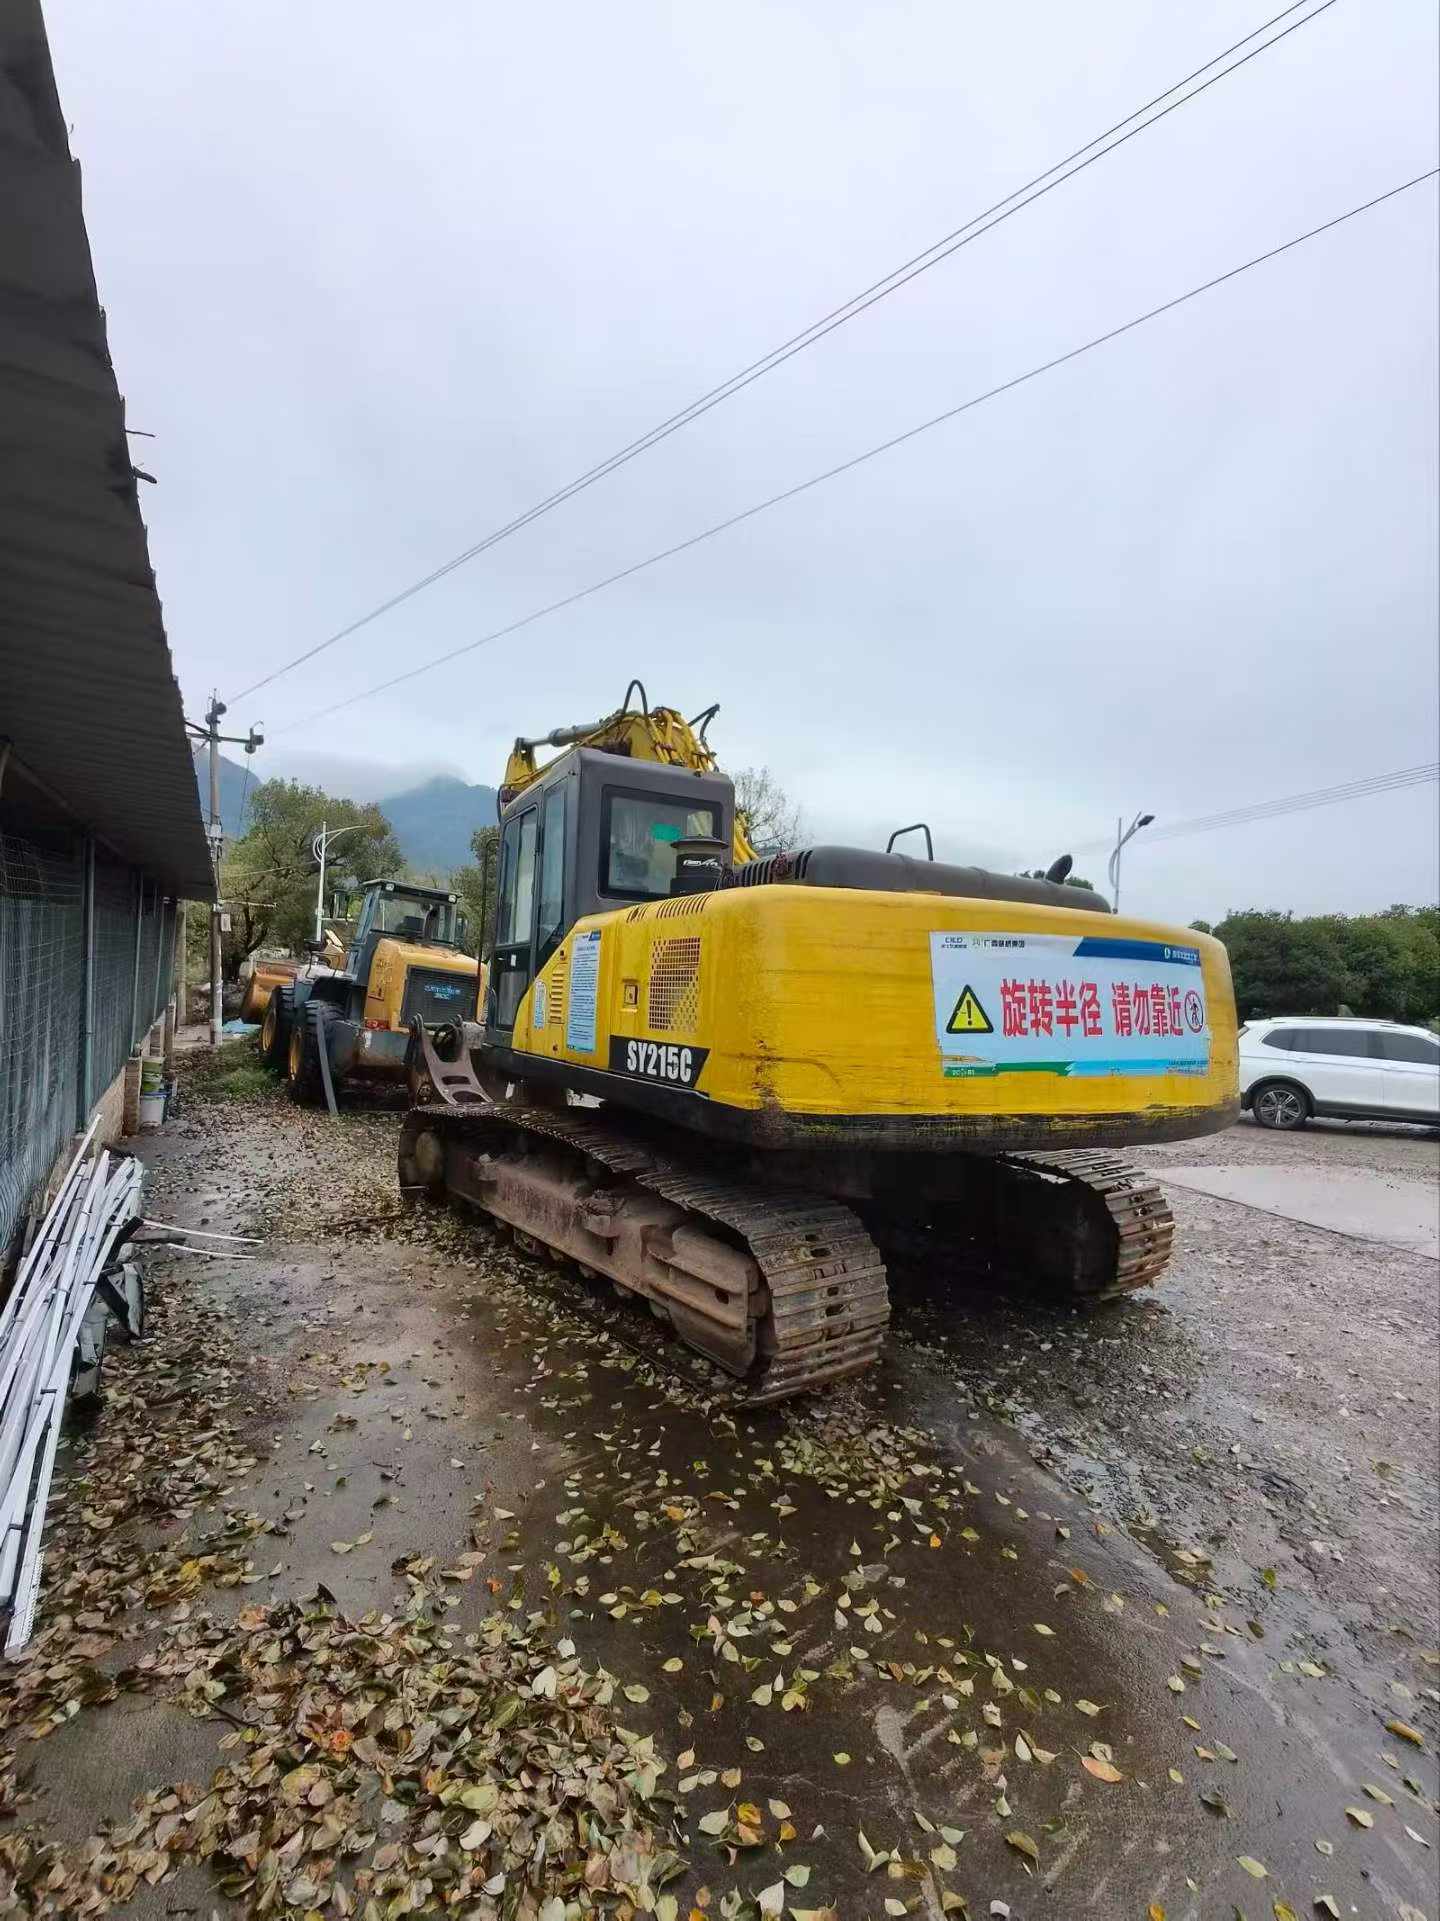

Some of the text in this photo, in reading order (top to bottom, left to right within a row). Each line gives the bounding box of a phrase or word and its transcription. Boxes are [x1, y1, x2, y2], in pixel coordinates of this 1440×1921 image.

[1000, 979, 1184, 1037] 旋转半径 请勿靠近
[627, 1040, 692, 1083] SY215C
